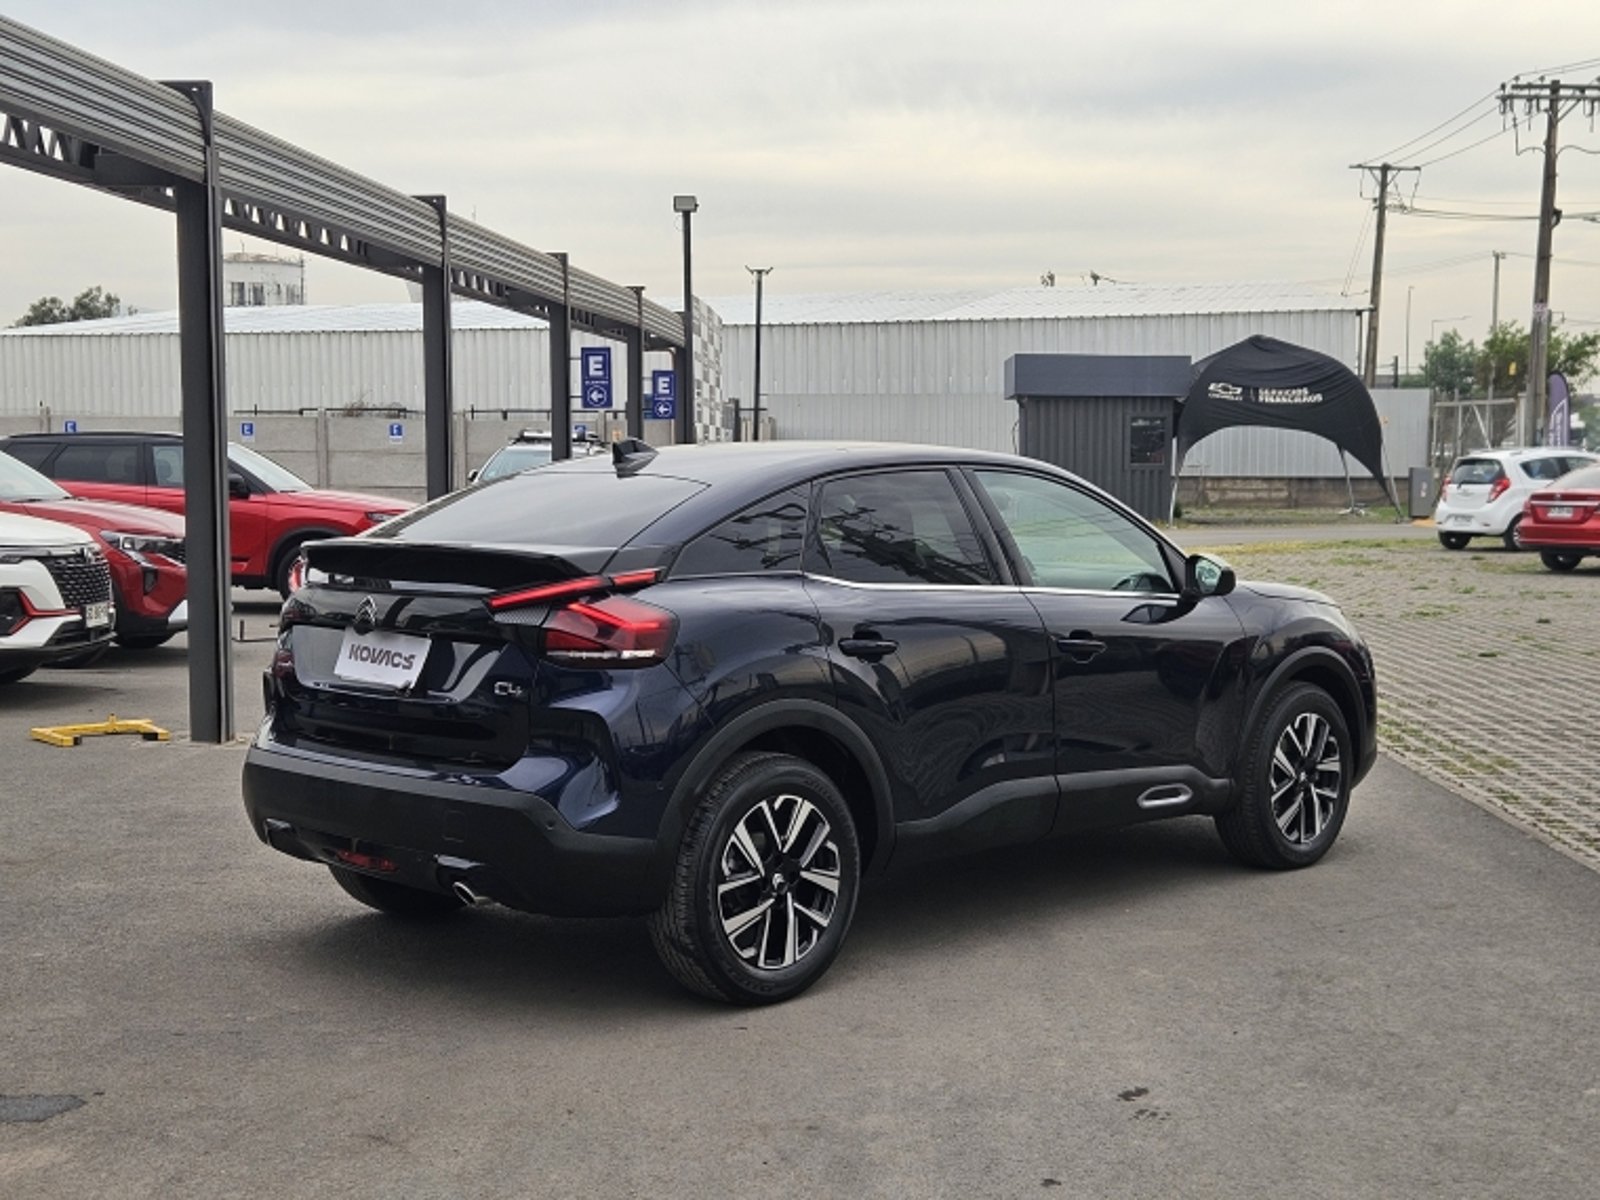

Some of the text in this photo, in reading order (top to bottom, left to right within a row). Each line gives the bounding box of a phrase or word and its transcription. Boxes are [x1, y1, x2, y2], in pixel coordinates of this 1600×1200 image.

[588, 355, 604, 376] E
[657, 376, 670, 394] E
[349, 644, 416, 670] KOVACS
[494, 681, 523, 696] C4
